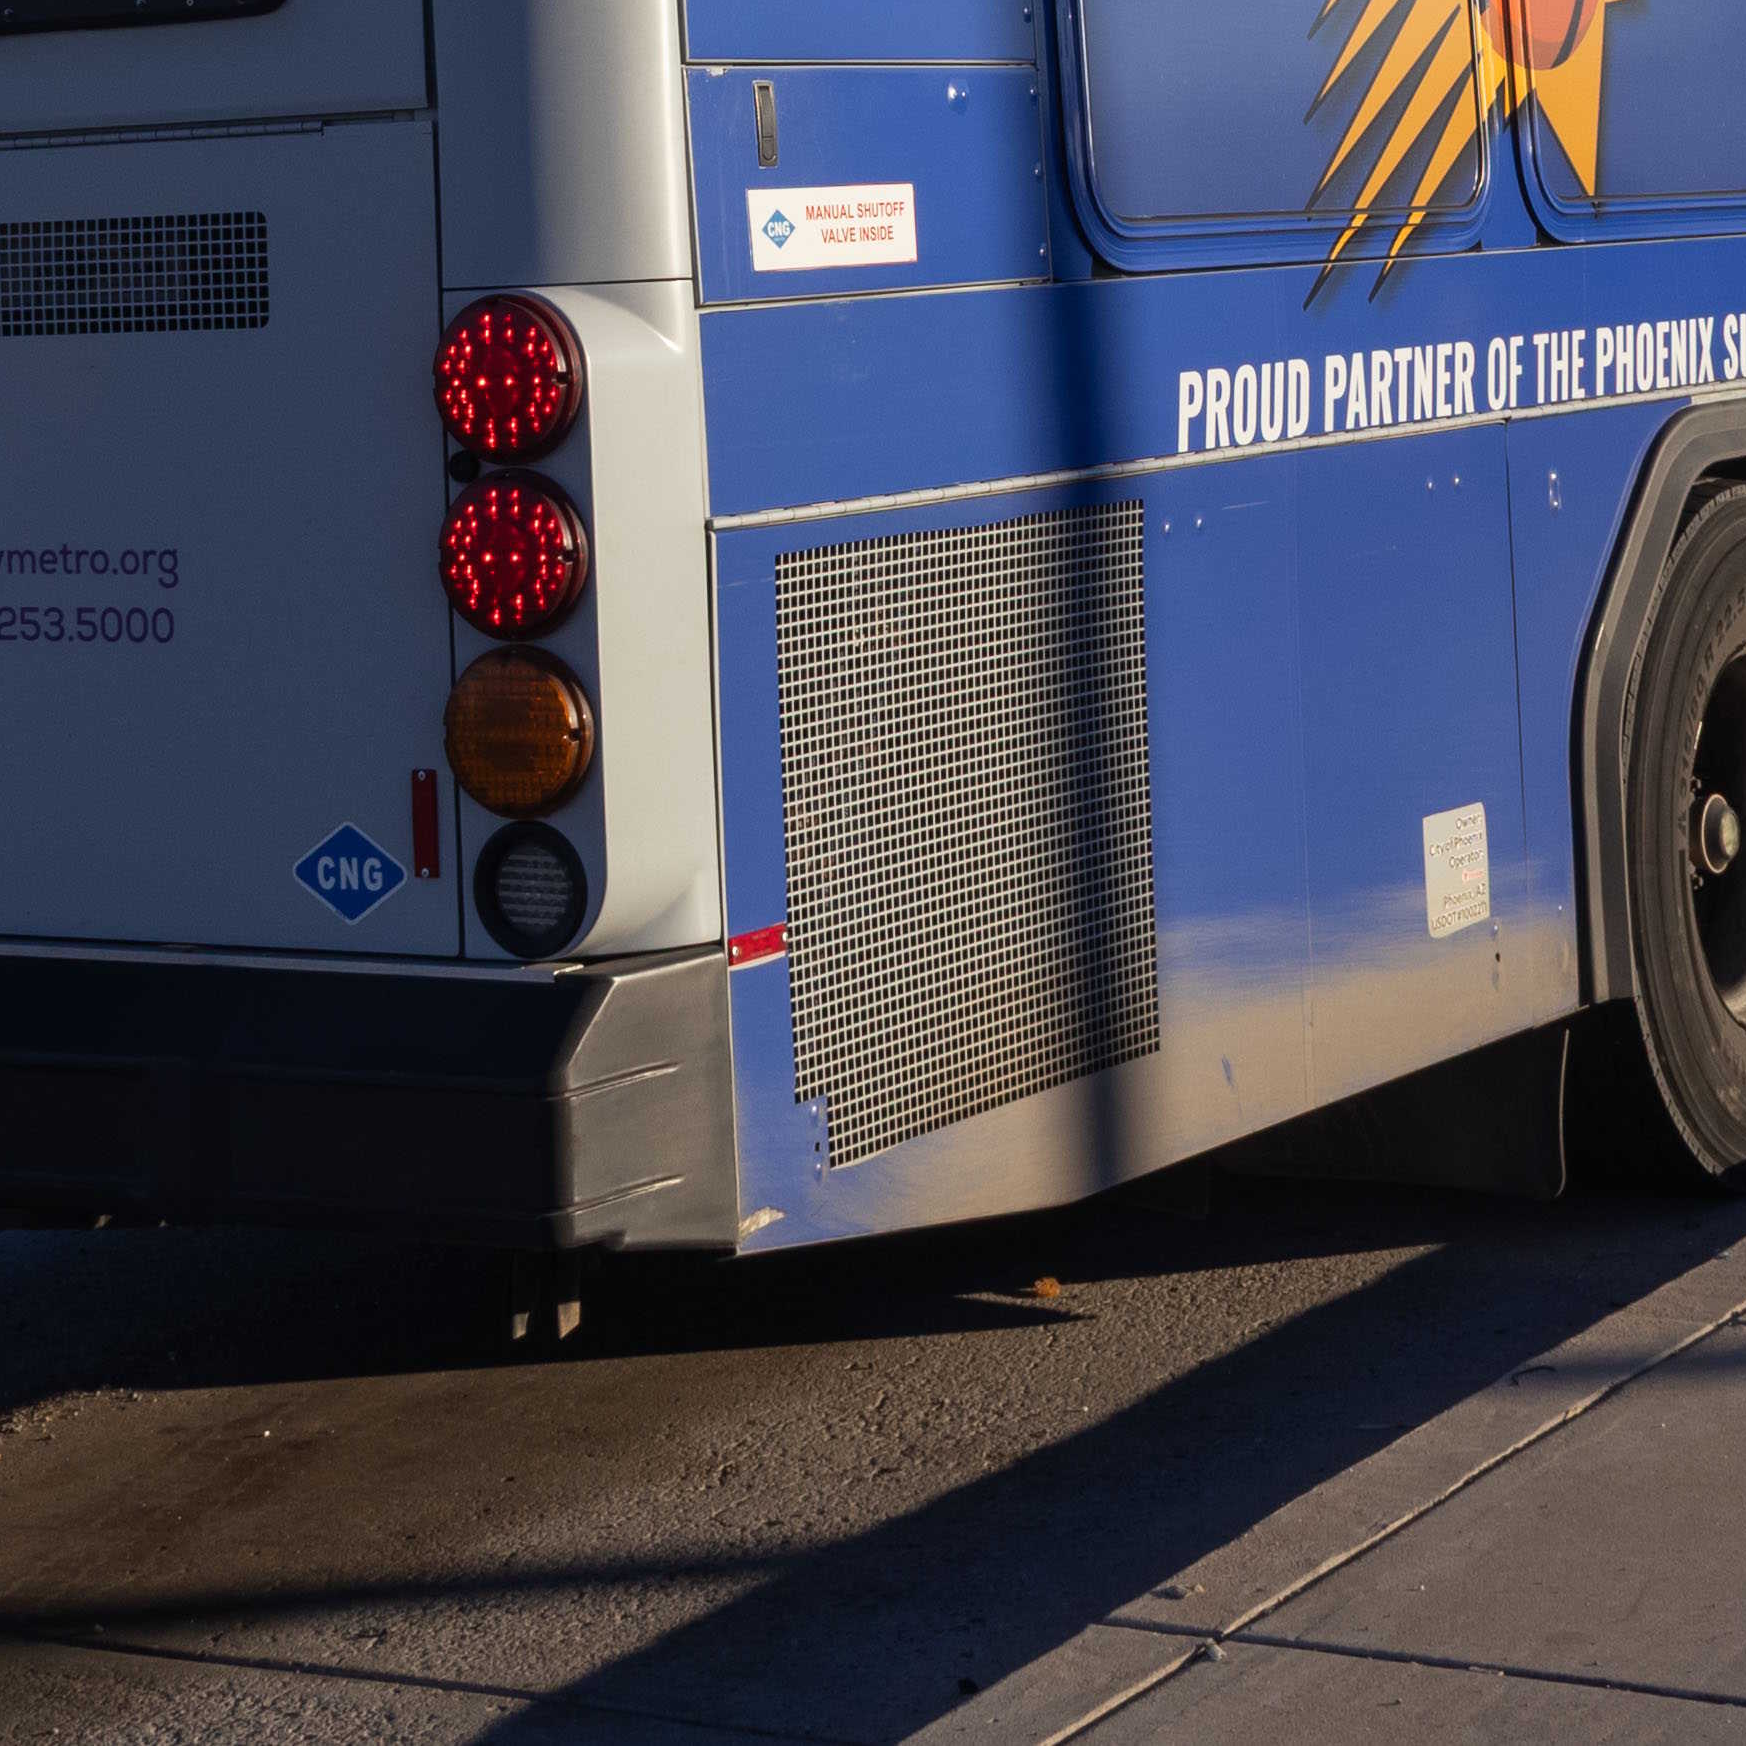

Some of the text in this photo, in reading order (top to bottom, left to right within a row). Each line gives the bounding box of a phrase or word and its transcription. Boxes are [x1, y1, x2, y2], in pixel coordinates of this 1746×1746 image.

[805, 201, 905, 220] MANUAL SHUTOFF
[767, 221, 791, 237] CNG
[821, 225, 894, 243] VALVE INSIDE
[1177, 357, 1310, 453] PROUD
[1324, 340, 1476, 433] PARTNER
[1487, 335, 1523, 410] OF
[1533, 328, 1587, 403] THE
[1595, 316, 1715, 396] PHOENIX
[316, 855, 384, 893] CNG
